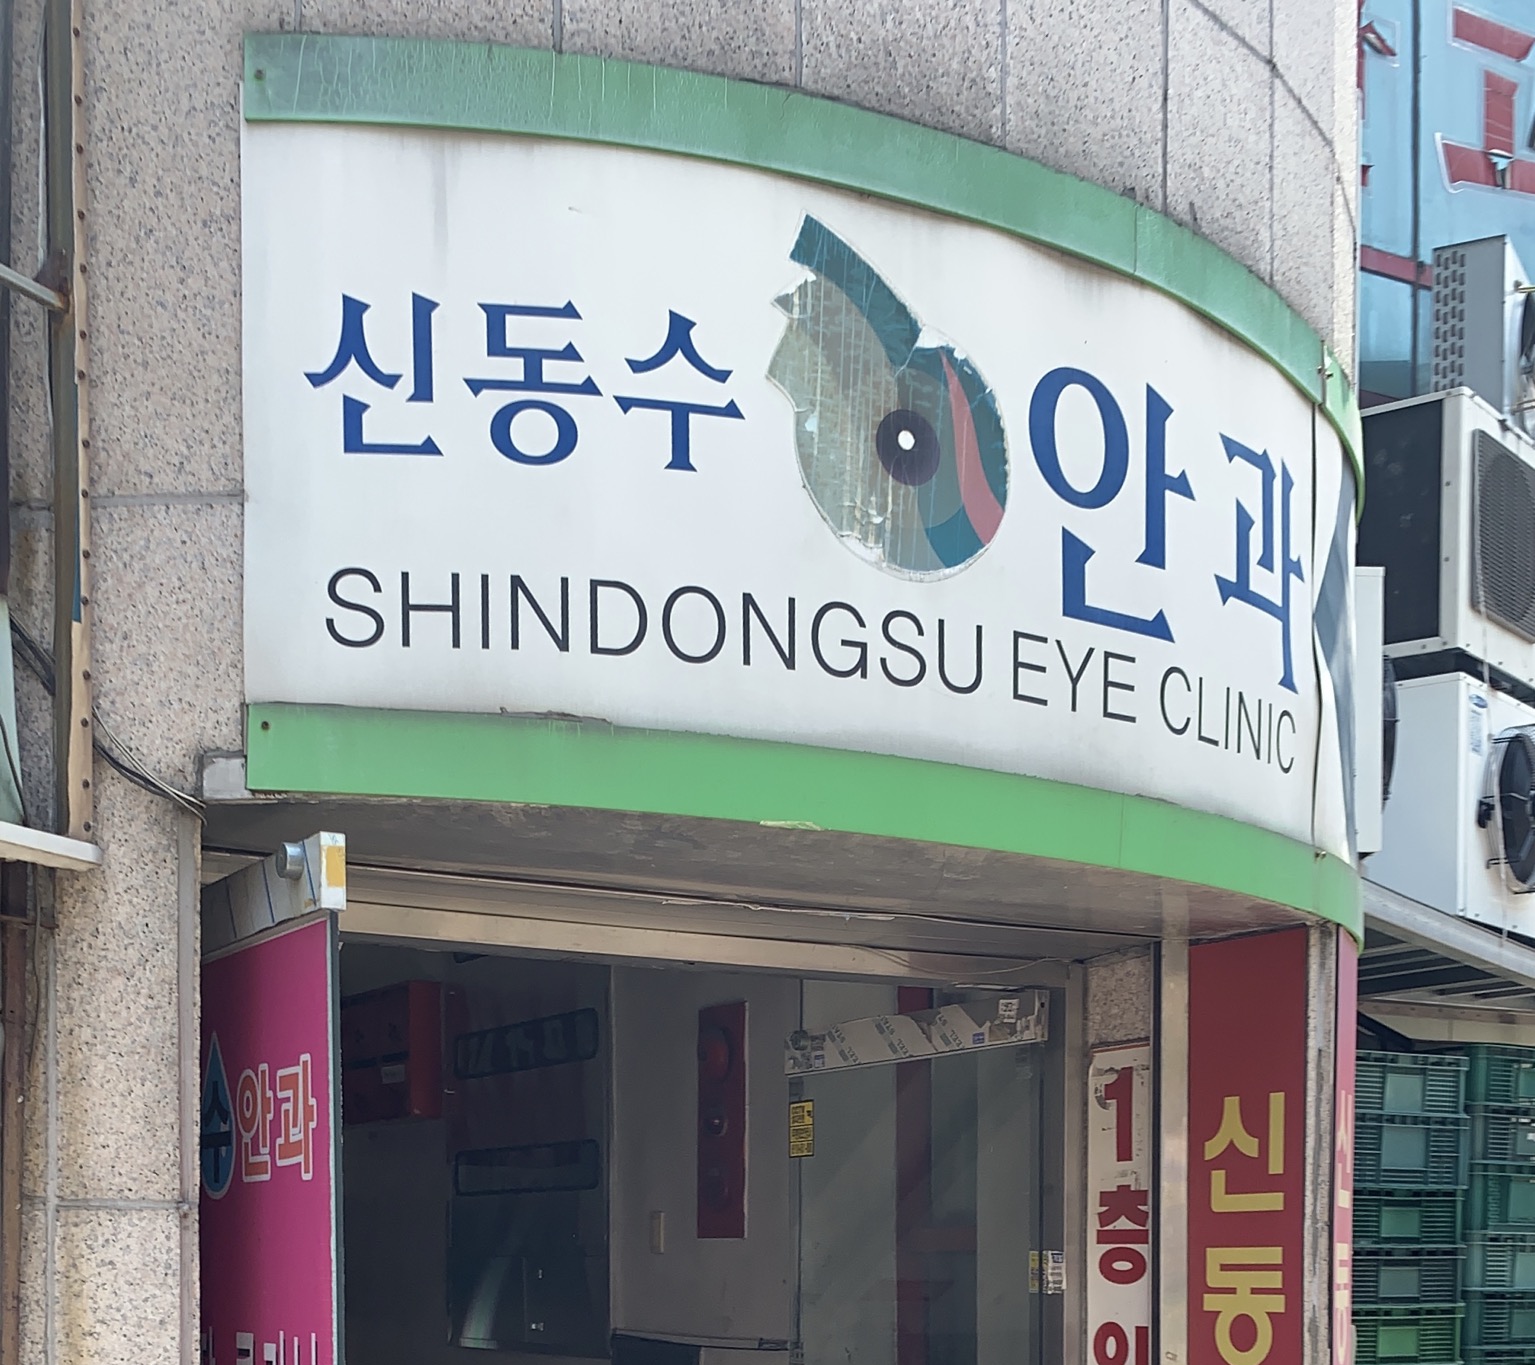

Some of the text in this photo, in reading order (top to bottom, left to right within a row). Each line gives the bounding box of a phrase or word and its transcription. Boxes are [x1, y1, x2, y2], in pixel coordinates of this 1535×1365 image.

[304, 291, 1305, 695] 신동수 안과
[323, 566, 1297, 776] SHINDONGSU EYE CLINIC
[1095, 1066, 1149, 1285] 1층
